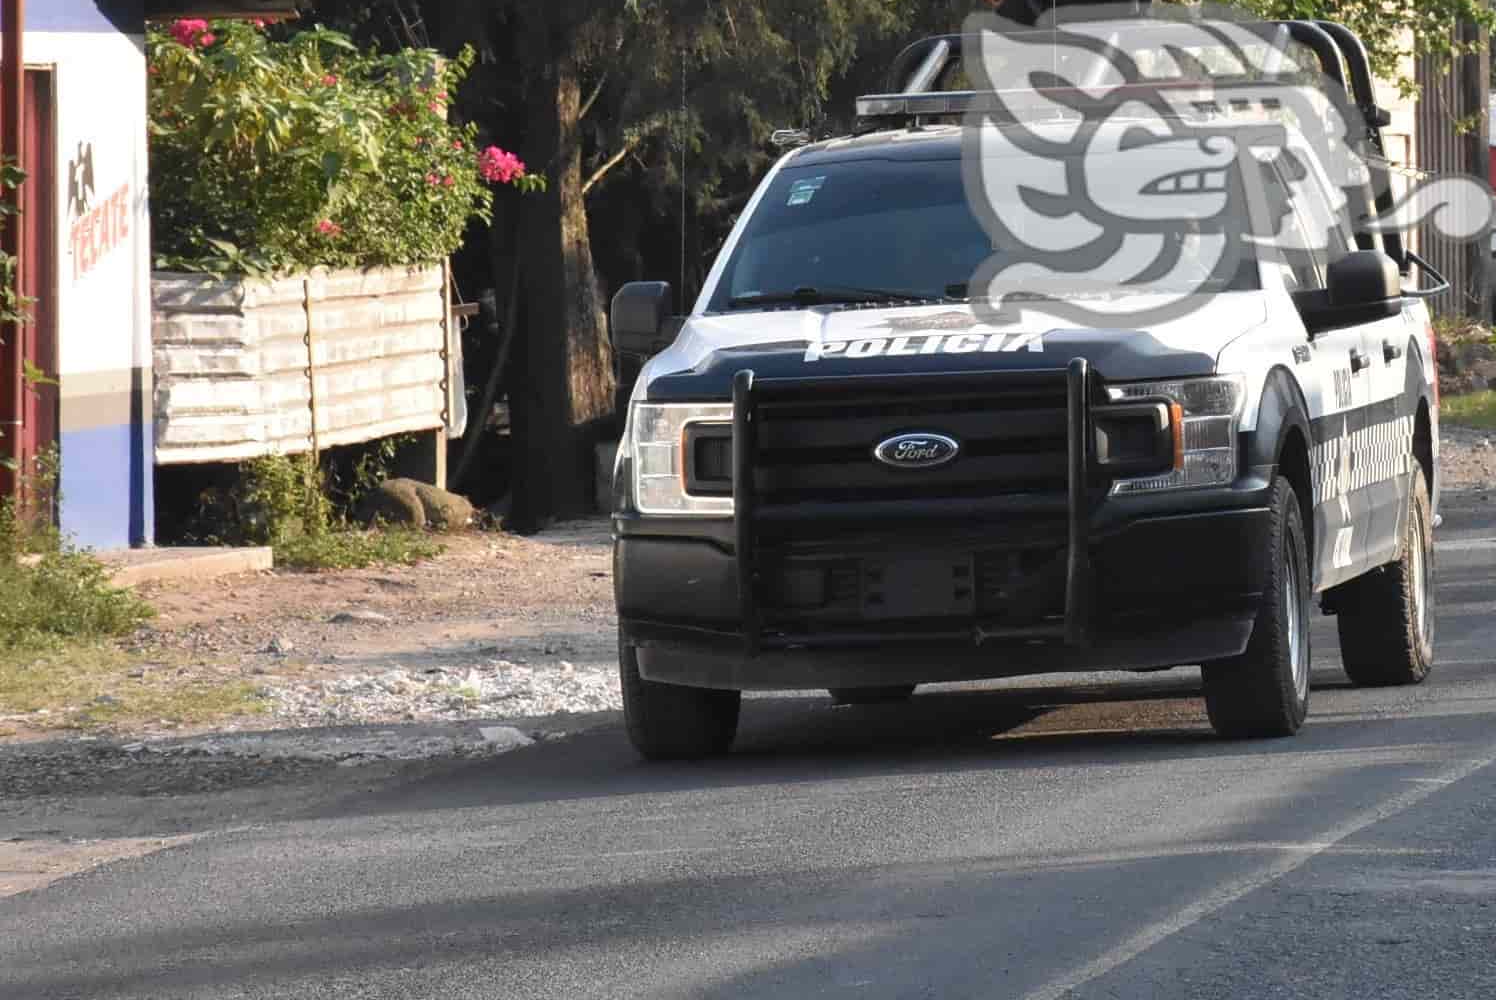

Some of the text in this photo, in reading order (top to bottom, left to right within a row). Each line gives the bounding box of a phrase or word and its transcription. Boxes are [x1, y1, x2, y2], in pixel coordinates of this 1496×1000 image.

[69, 183, 129, 281] TECATE
[803, 332, 1044, 363] POLICIA
[895, 439, 938, 460] Ford
